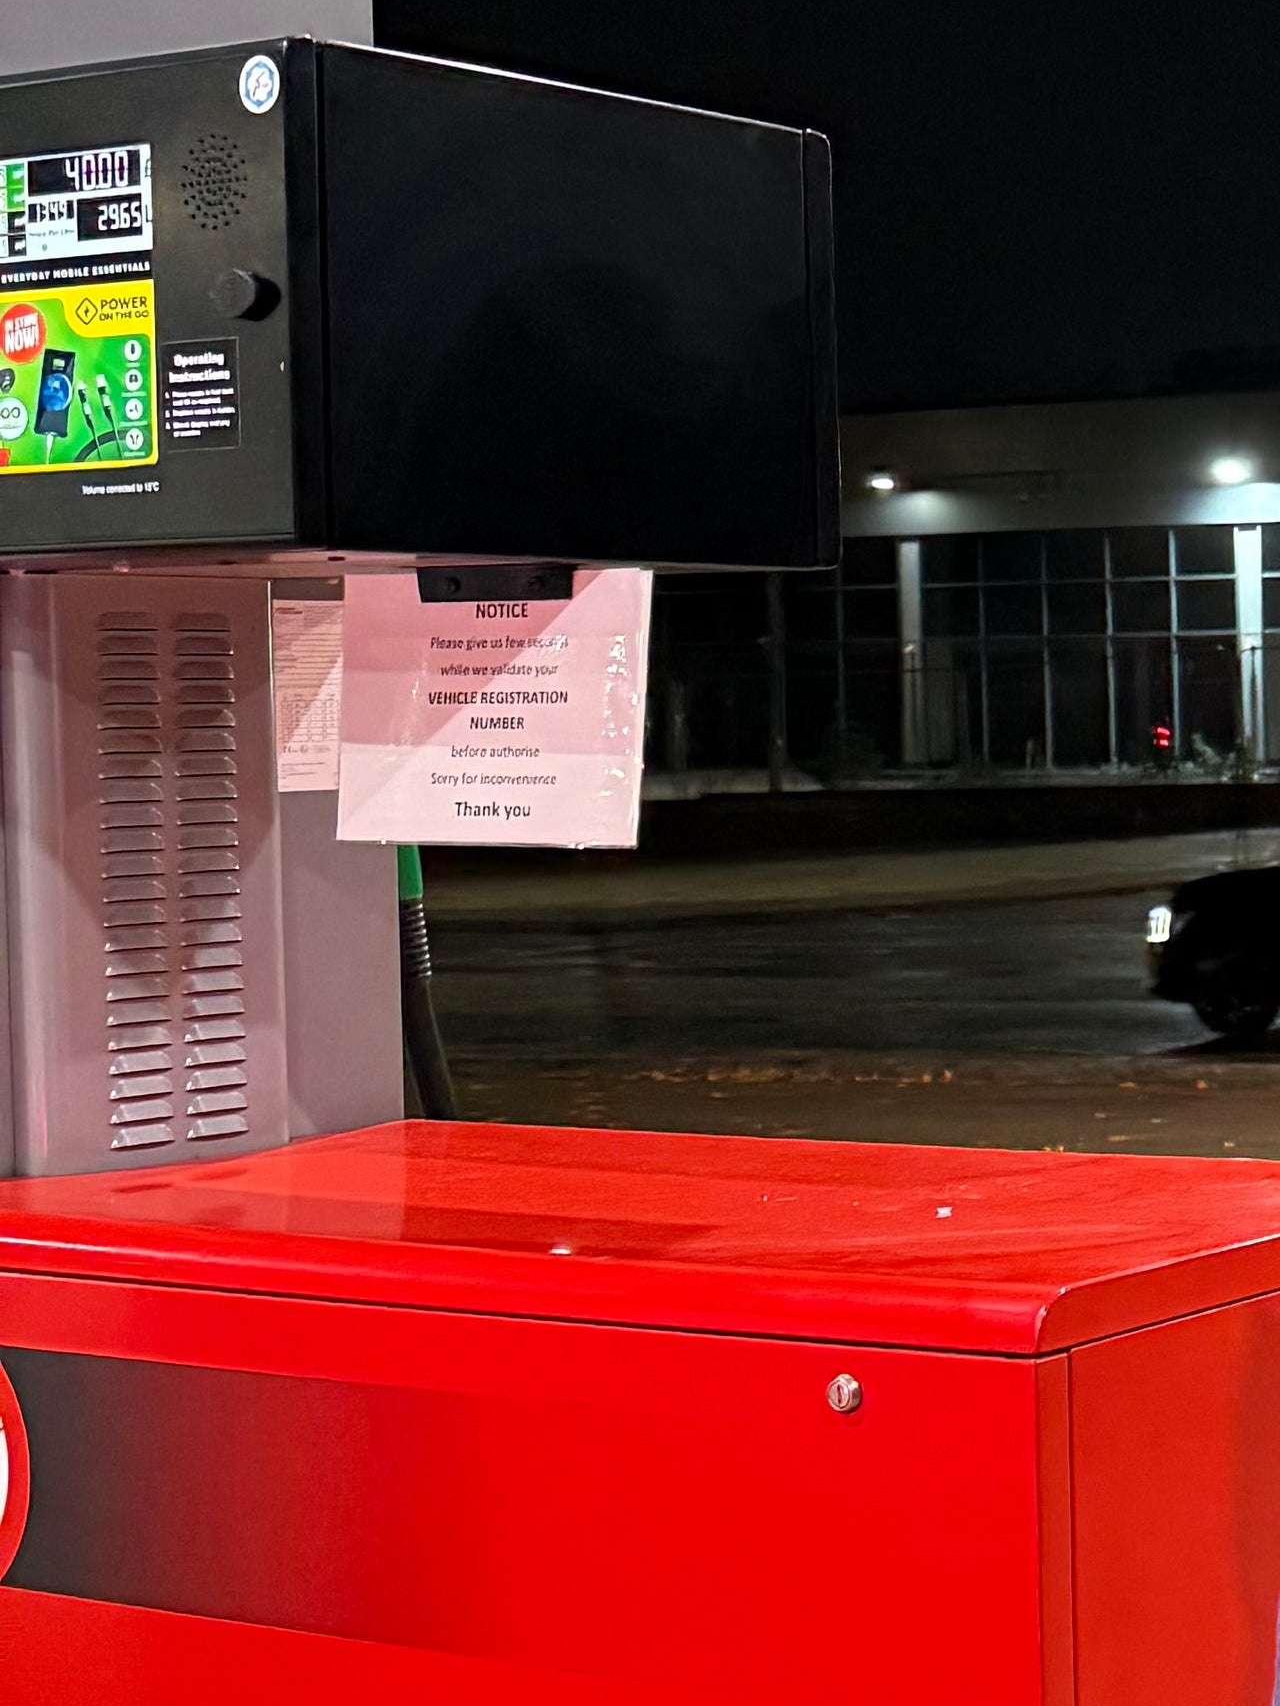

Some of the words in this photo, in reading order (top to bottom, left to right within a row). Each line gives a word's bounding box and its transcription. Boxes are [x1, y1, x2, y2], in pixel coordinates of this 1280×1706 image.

[1, 271, 50, 284] EVERYDAY
[53, 266, 89, 279] MOBILE
[92, 261, 150, 276] ESSENTIALS
[100, 296, 148, 310] POWER
[99, 313, 113, 321] ON
[116, 311, 132, 320] THE
[135, 309, 149, 318] GO
[5, 325, 40, 354] NOW!
[174, 352, 225, 368] Operating
[476, 603, 528, 618] NOTICE
[430, 636, 464, 649] Please
[467, 637, 488, 651] give
[491, 639, 503, 648] us
[505, 635, 525, 648] few
[441, 664, 470, 676] while
[472, 668, 488, 676] we
[490, 663, 532, 676] validate
[535, 665, 559, 677] your
[428, 691, 478, 704] VEHICLE
[480, 691, 568, 704] REGISTRATION
[470, 716, 524, 730] NUMBER
[451, 745, 487, 758] before
[490, 746, 540, 758] authorise
[431, 772, 459, 787] Sorry
[462, 772, 478, 785] for
[455, 801, 500, 817] Thank
[504, 805, 531, 821] you
